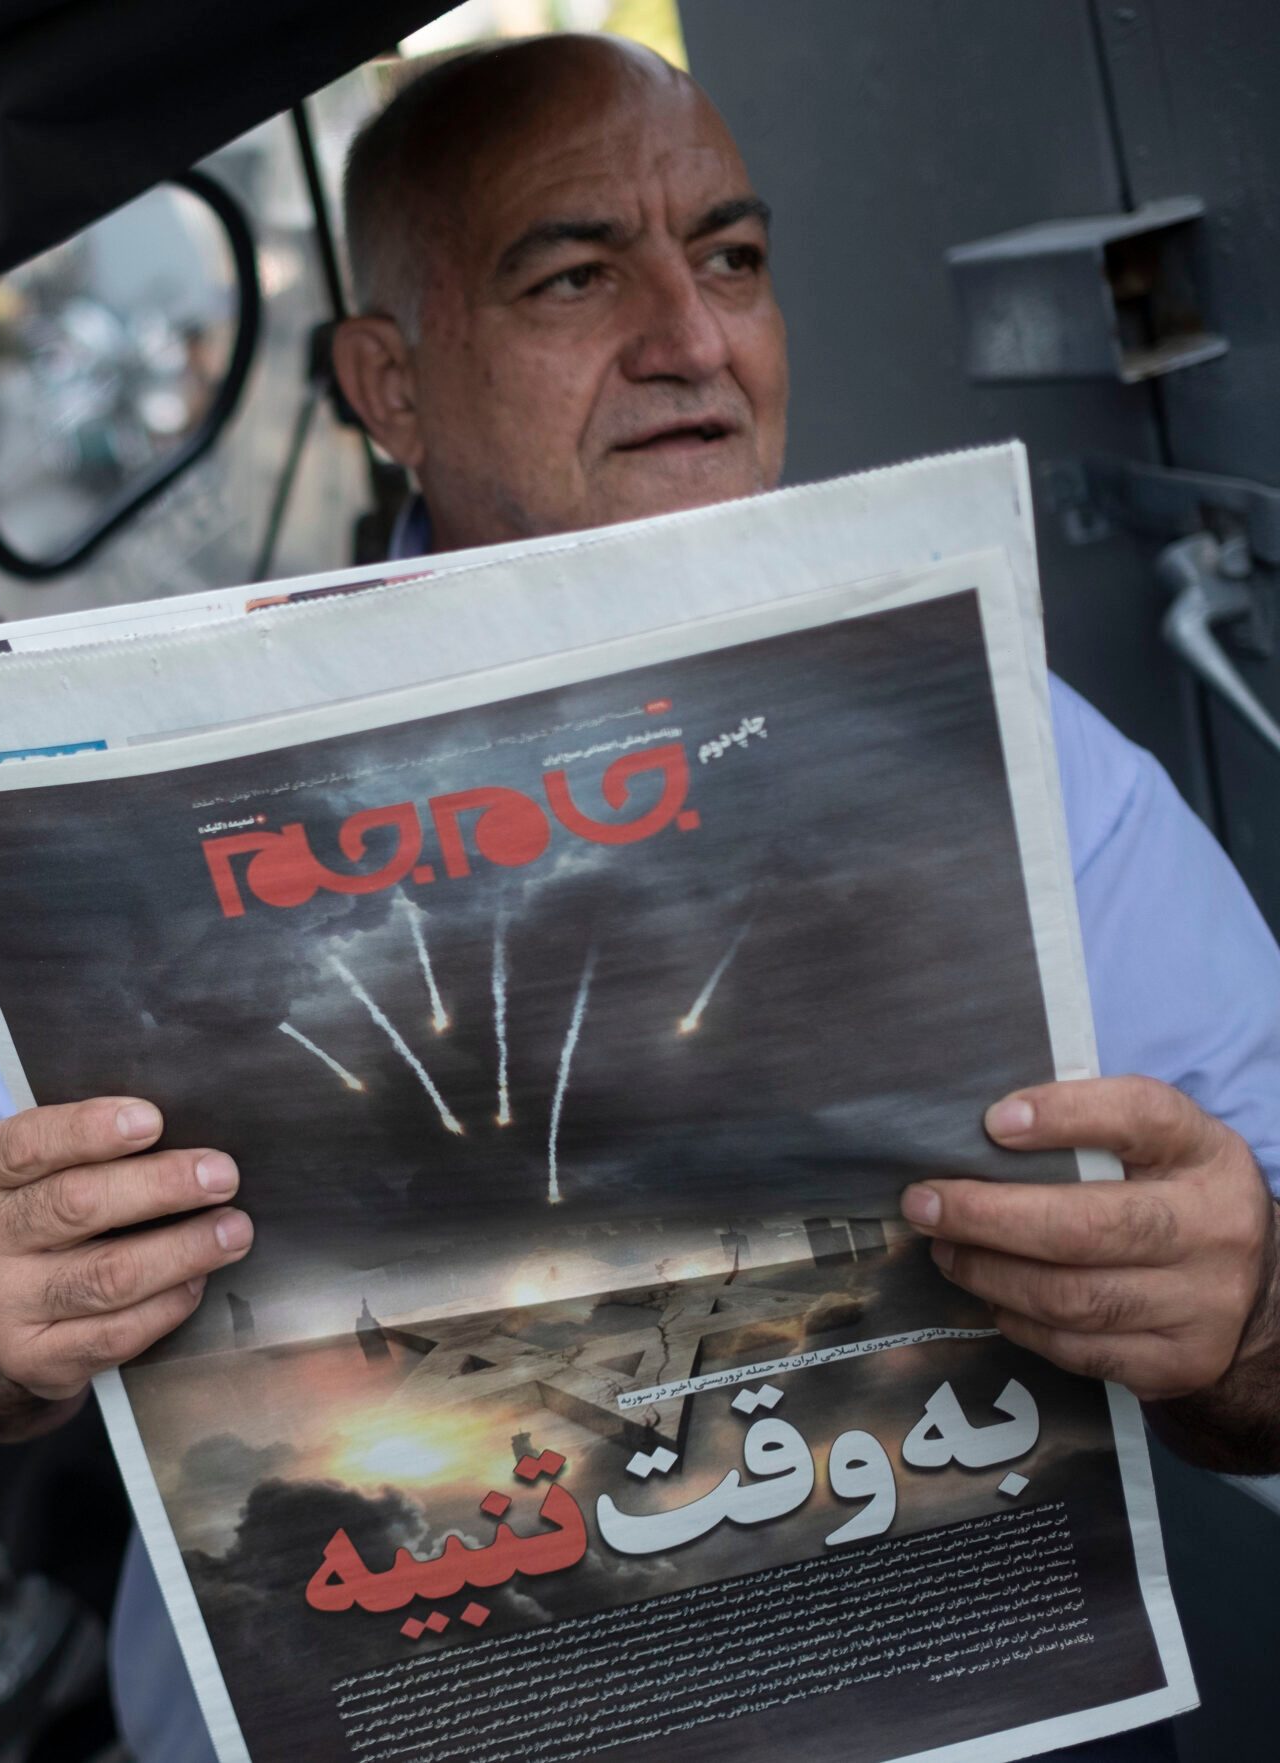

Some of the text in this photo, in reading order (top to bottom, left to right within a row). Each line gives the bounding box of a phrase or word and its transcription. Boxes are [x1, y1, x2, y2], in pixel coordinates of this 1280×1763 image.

[697, 716, 767, 765] چاپ دوم
[862, 1335, 909, 1353] جمهوری
[791, 1353, 818, 1368] ایران
[820, 1342, 860, 1363] اسلامی
[745, 1363, 775, 1377] حمله
[778, 1360, 790, 1370] به
[669, 1380, 692, 1396] اخیر
[693, 1369, 744, 1391] تروریستی
[620, 1392, 653, 1406] سوریه
[655, 1388, 667, 1400] در
[304, 1375, 1042, 1641] به وقت تنبیه
